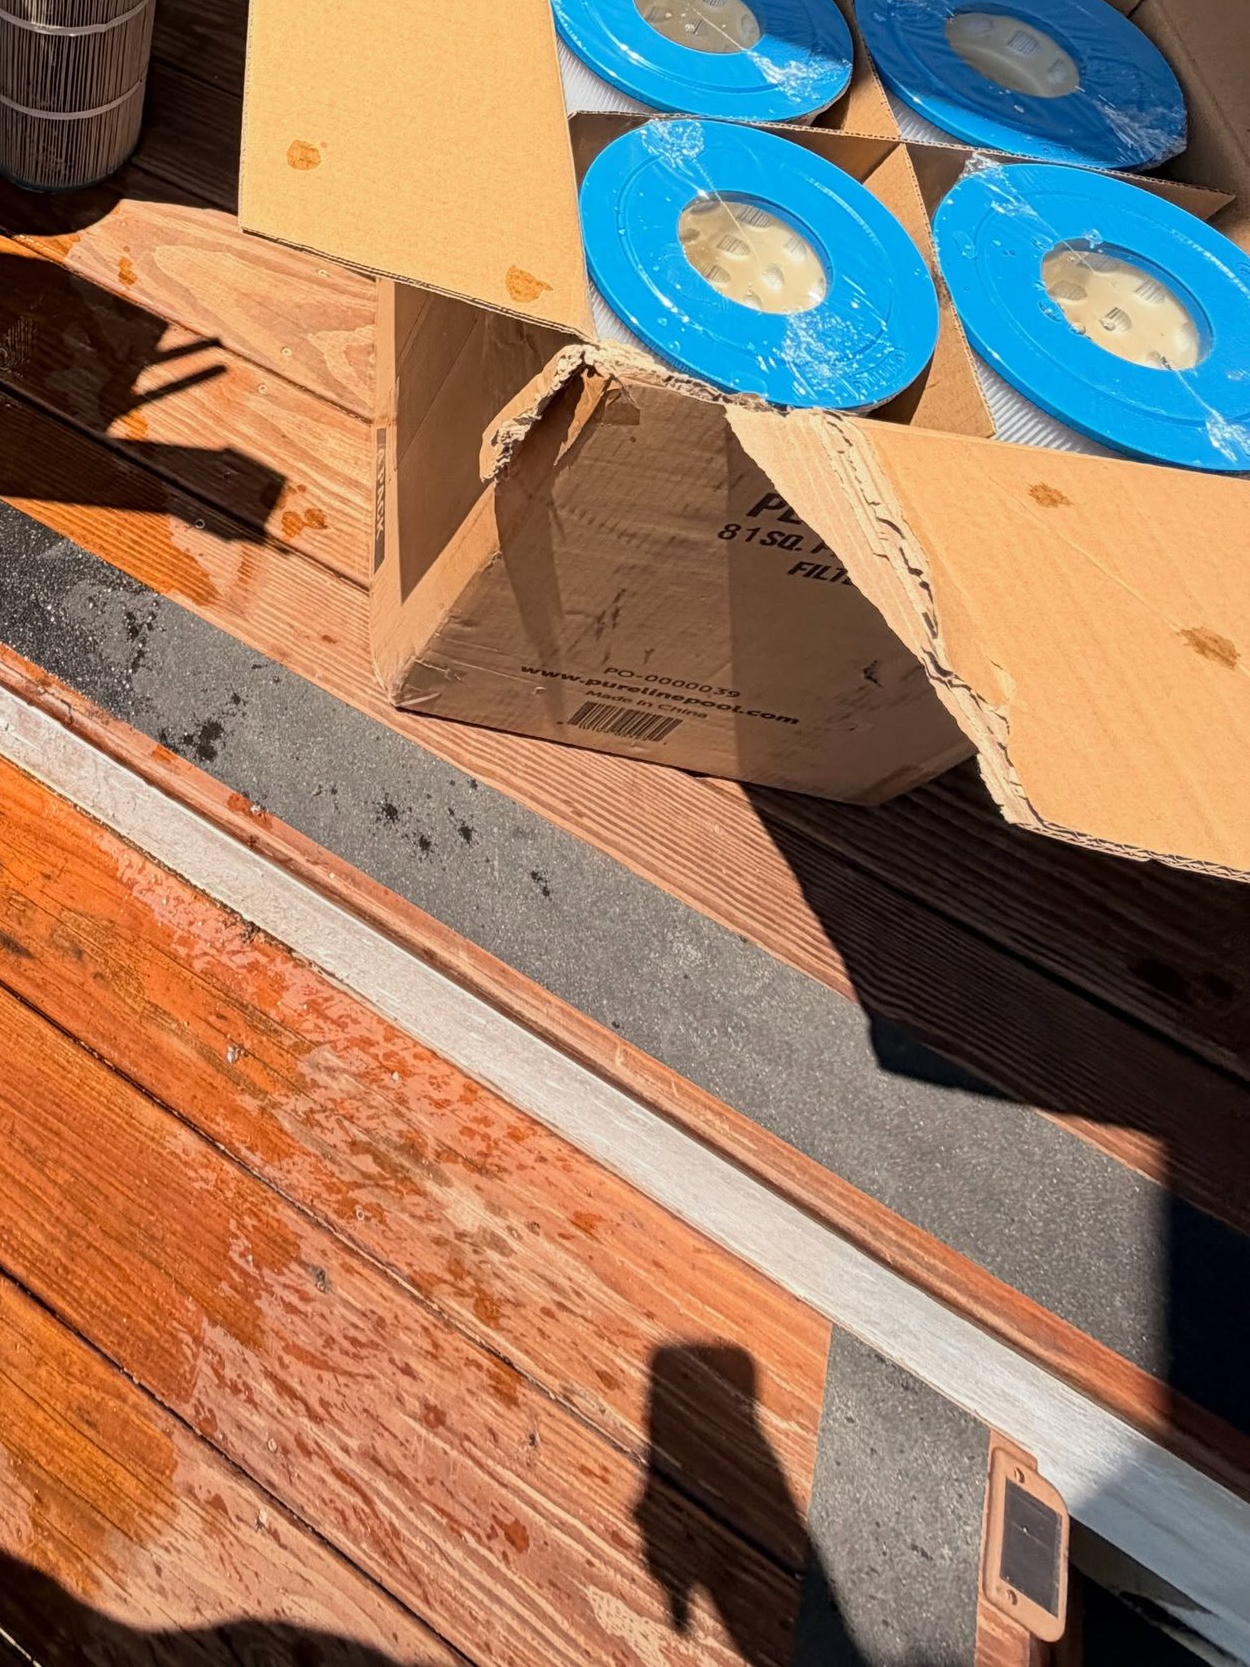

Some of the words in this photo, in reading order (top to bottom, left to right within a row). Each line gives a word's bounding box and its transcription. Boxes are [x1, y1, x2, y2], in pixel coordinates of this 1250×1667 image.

[520, 665, 799, 725] www.purelinepool.com
[585, 689, 632, 704] Made
[657, 702, 709, 720] China
